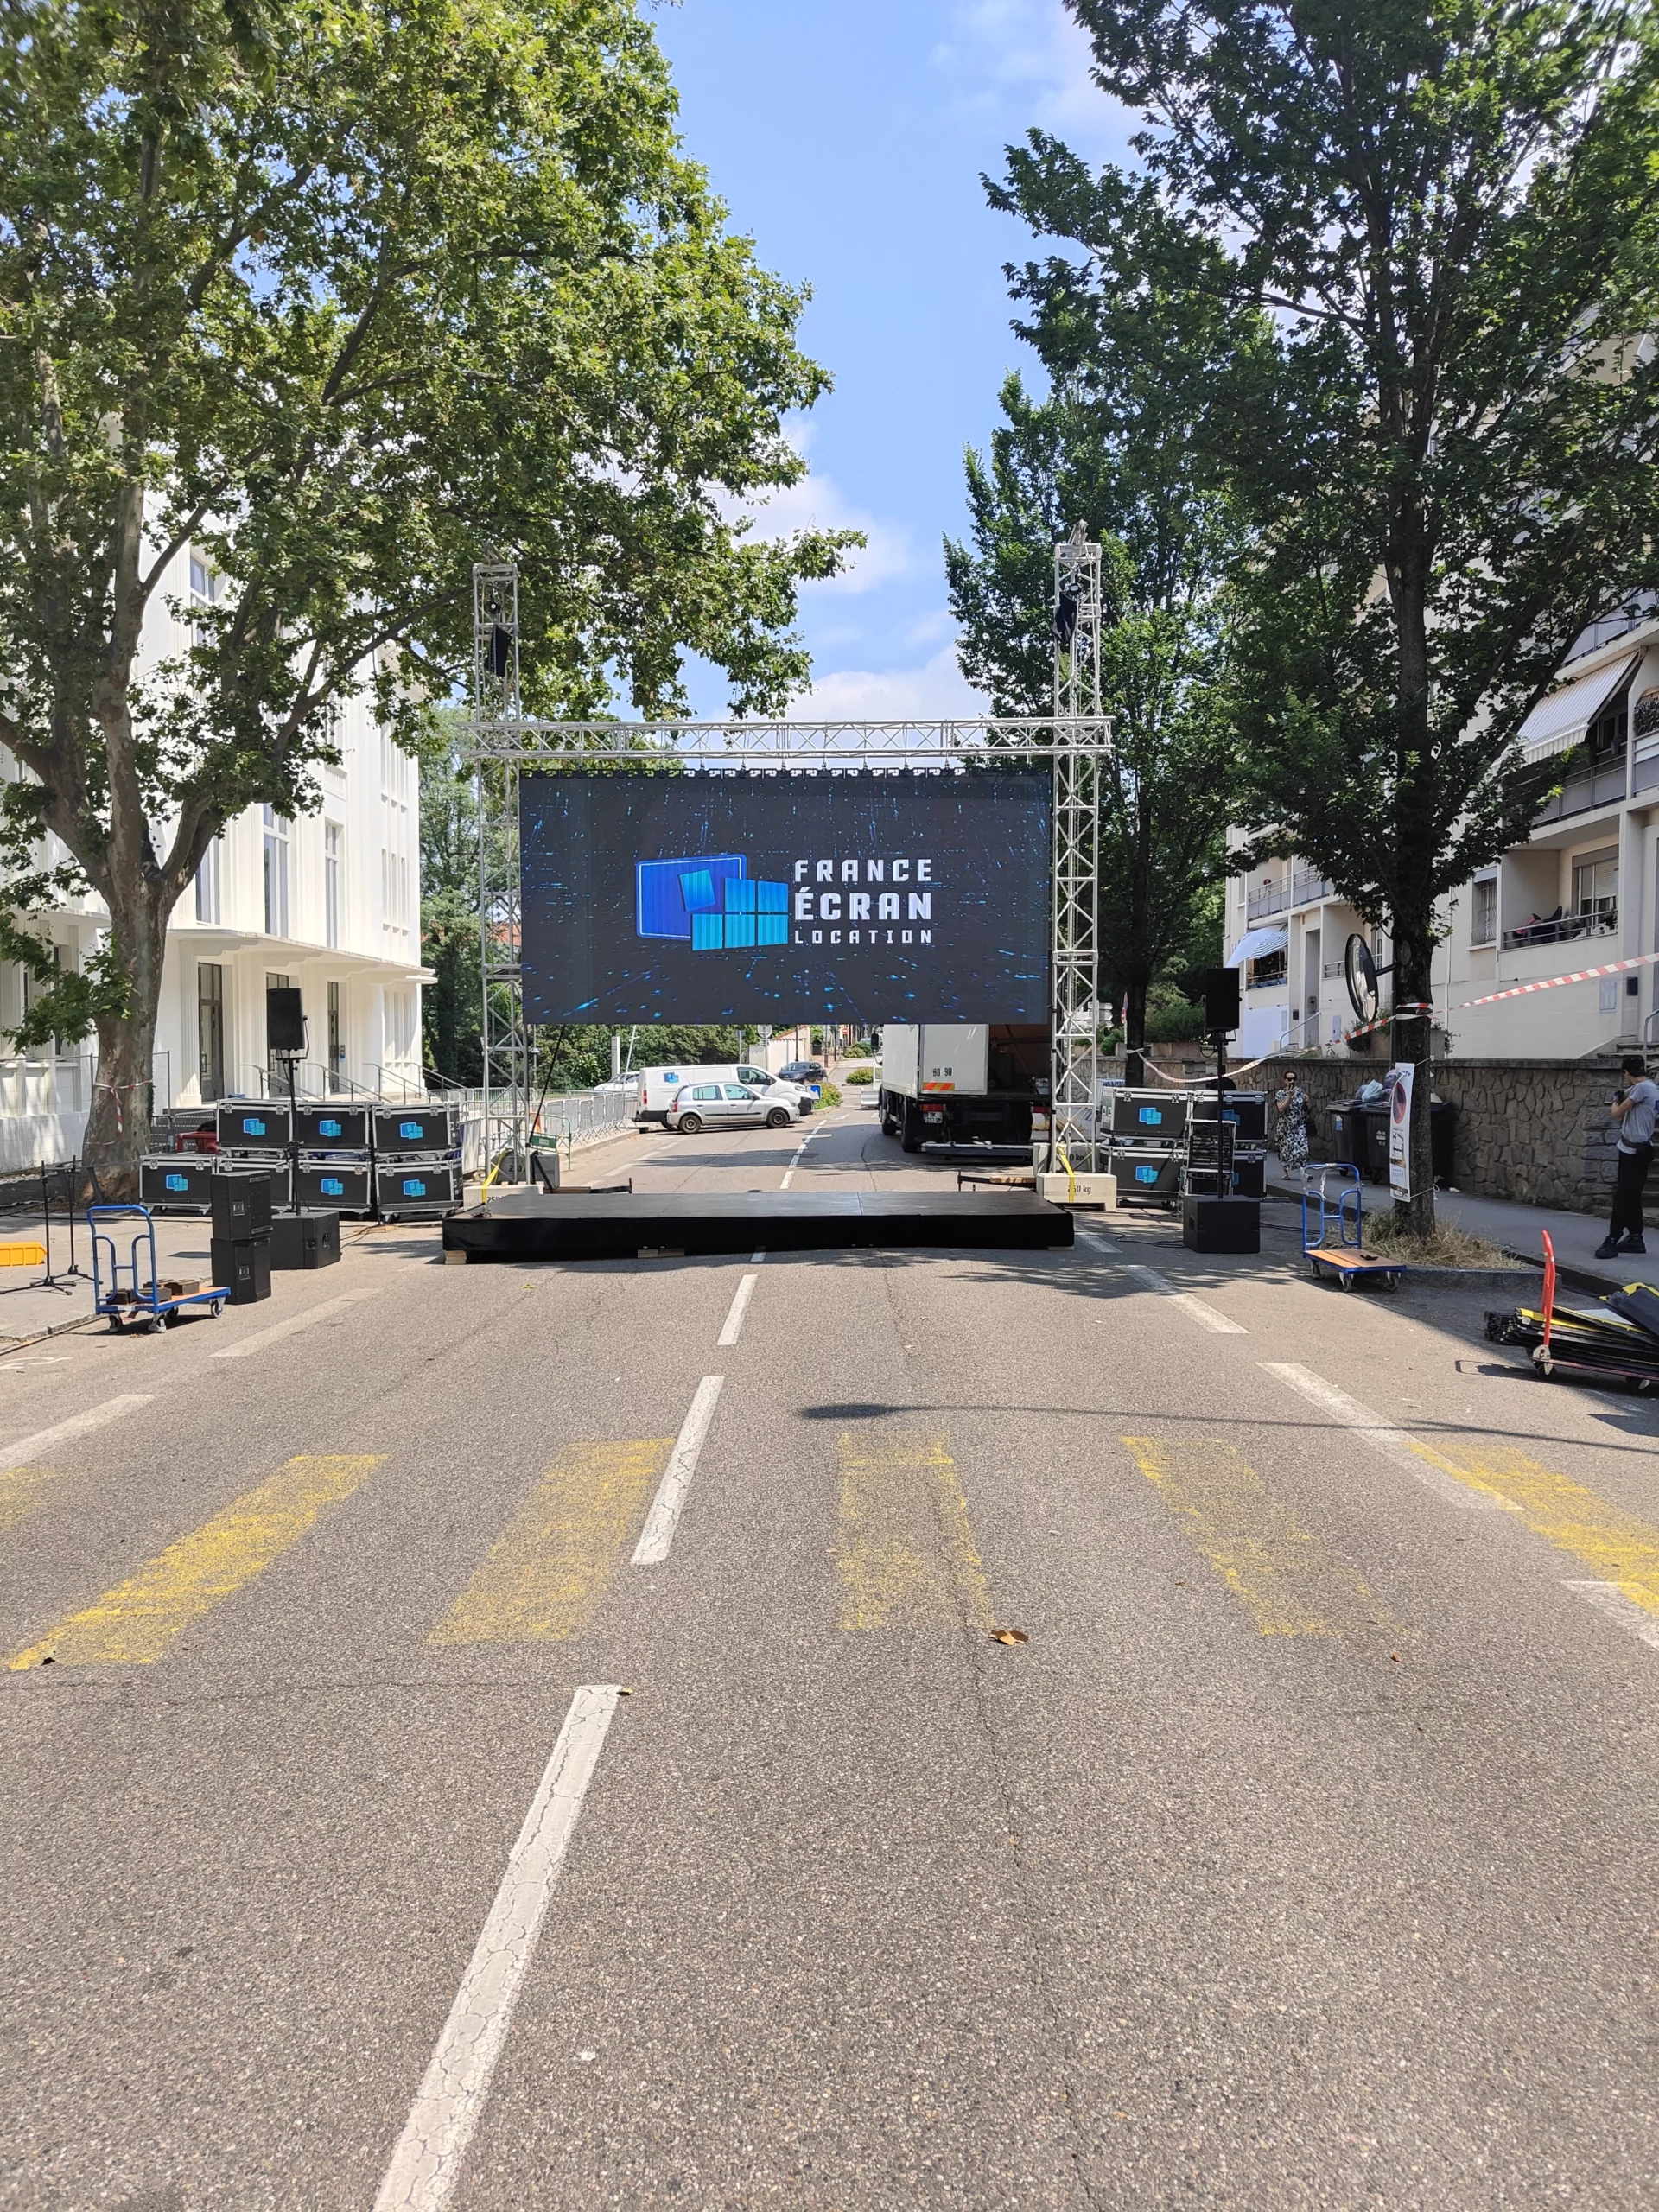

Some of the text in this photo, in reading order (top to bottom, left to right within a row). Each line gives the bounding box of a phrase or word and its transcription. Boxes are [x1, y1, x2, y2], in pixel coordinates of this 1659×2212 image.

[794, 859, 932, 882] FRANCE
[794, 887, 932, 920] ÉCRAN
[794, 929, 932, 944] LOCATION
[1083, 1185, 1091, 1194] kg
